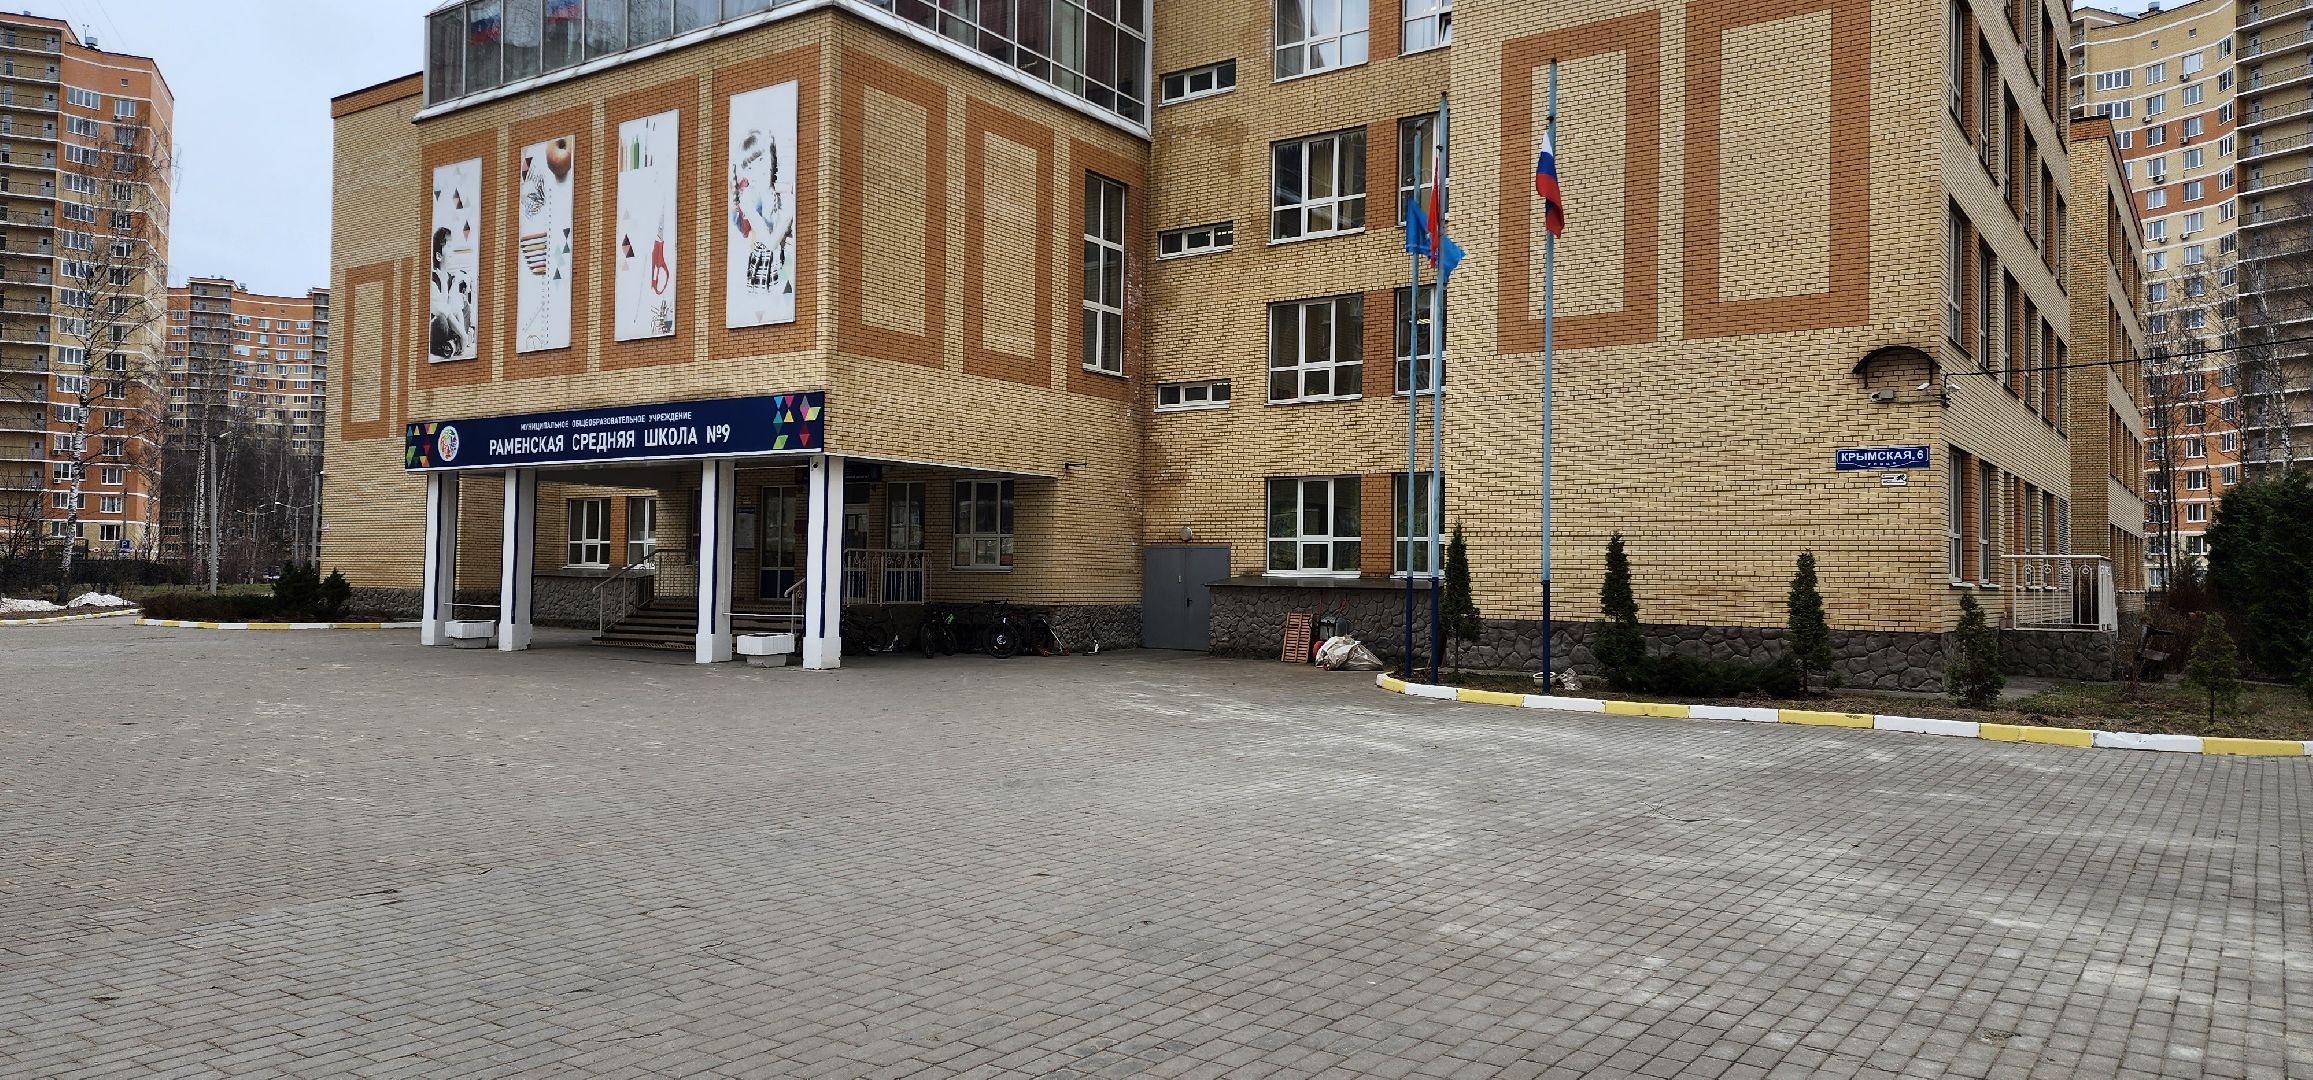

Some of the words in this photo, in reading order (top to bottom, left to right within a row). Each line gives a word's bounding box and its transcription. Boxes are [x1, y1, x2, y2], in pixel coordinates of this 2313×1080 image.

[520, 420, 569, 431] МУНИЦИПАЛЬНОЕ
[571, 415, 646, 427] ОБЩЕОБРАЗОВАТЕЛЬНОЕ
[648, 411, 692, 421] УЧРЕЖДЕНИЕ
[489, 434, 564, 456] РАМЕНСКАЯ
[572, 431, 635, 453] СРЕДНЯЯ
[644, 426, 698, 447] ШКОЛА
[706, 424, 731, 444] №9
[1841, 451, 1916, 461] КРЫМСКАЯ,
[1917, 450, 1924, 459] 6
